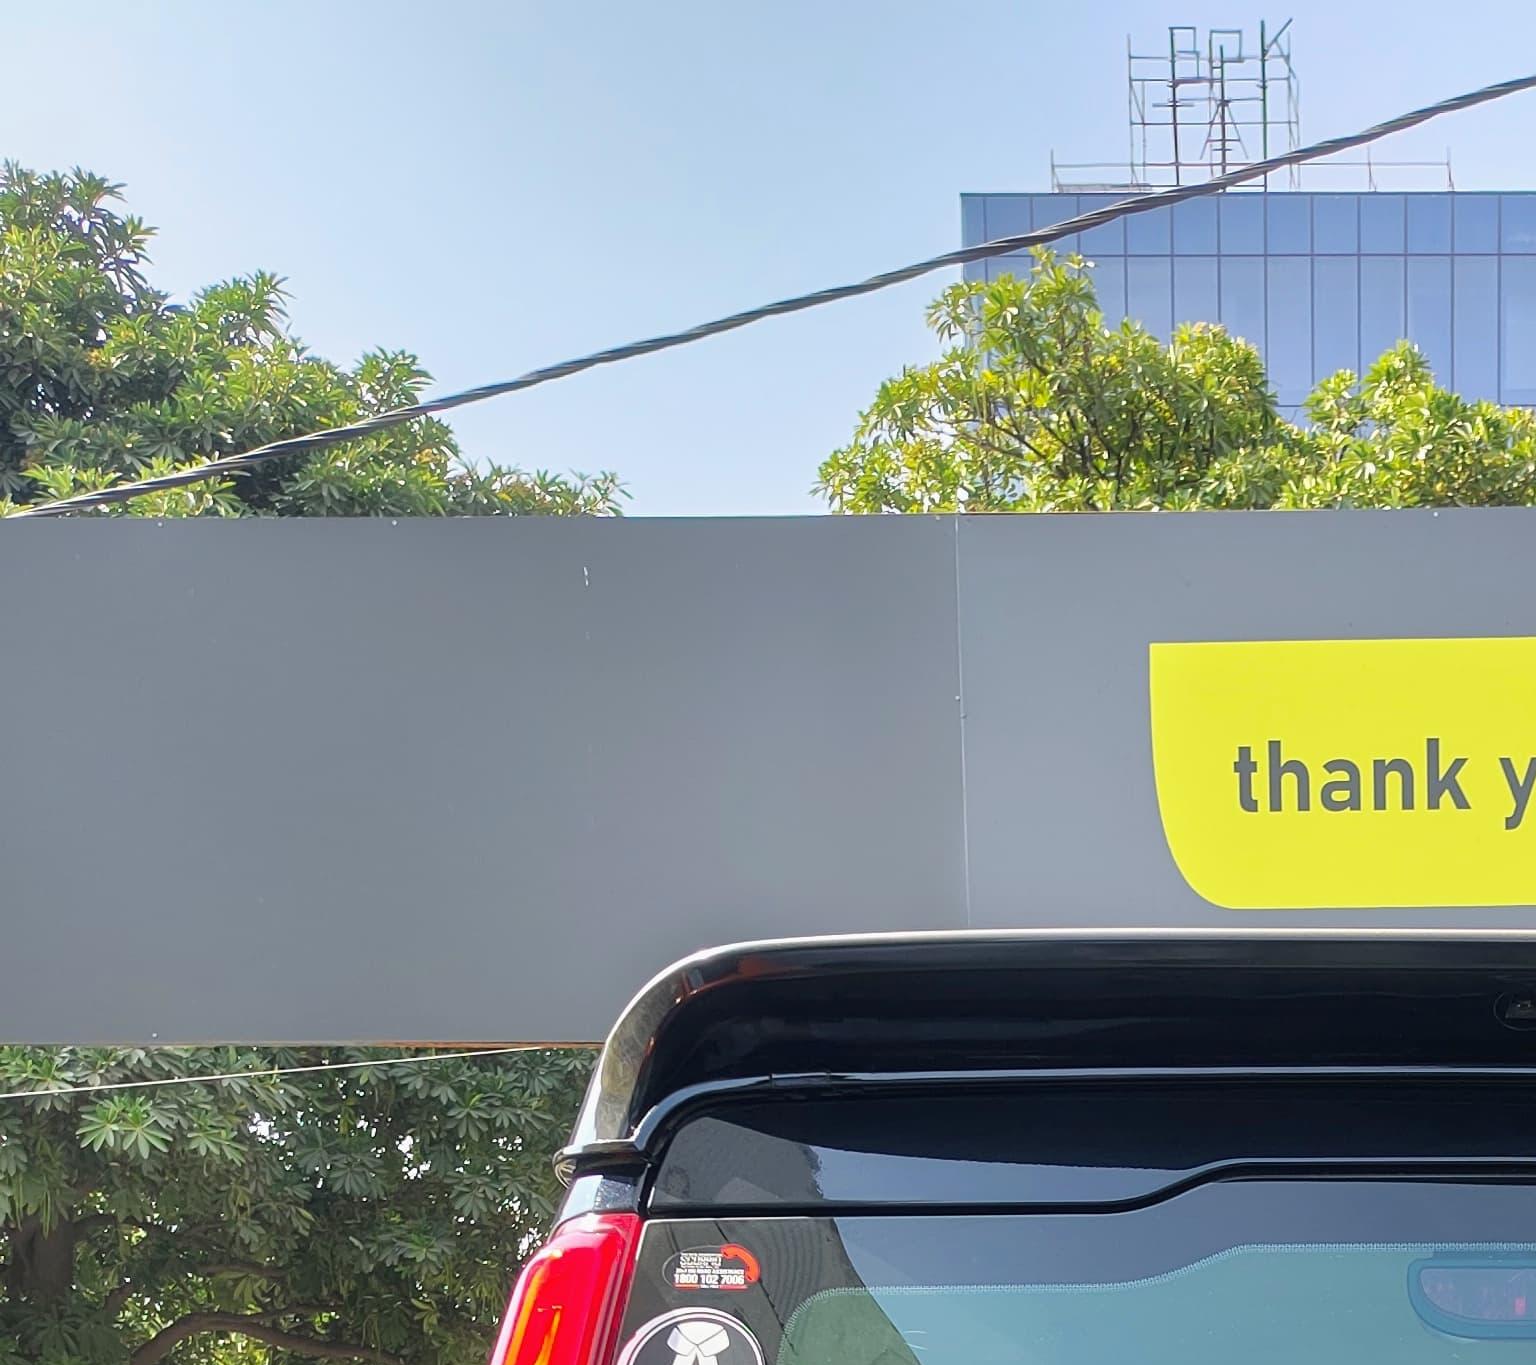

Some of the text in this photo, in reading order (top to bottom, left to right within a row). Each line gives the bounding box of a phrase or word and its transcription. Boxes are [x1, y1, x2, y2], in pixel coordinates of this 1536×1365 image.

[1234, 738, 1472, 813] thank
[674, 1274, 745, 1285] 1800 102 7006
